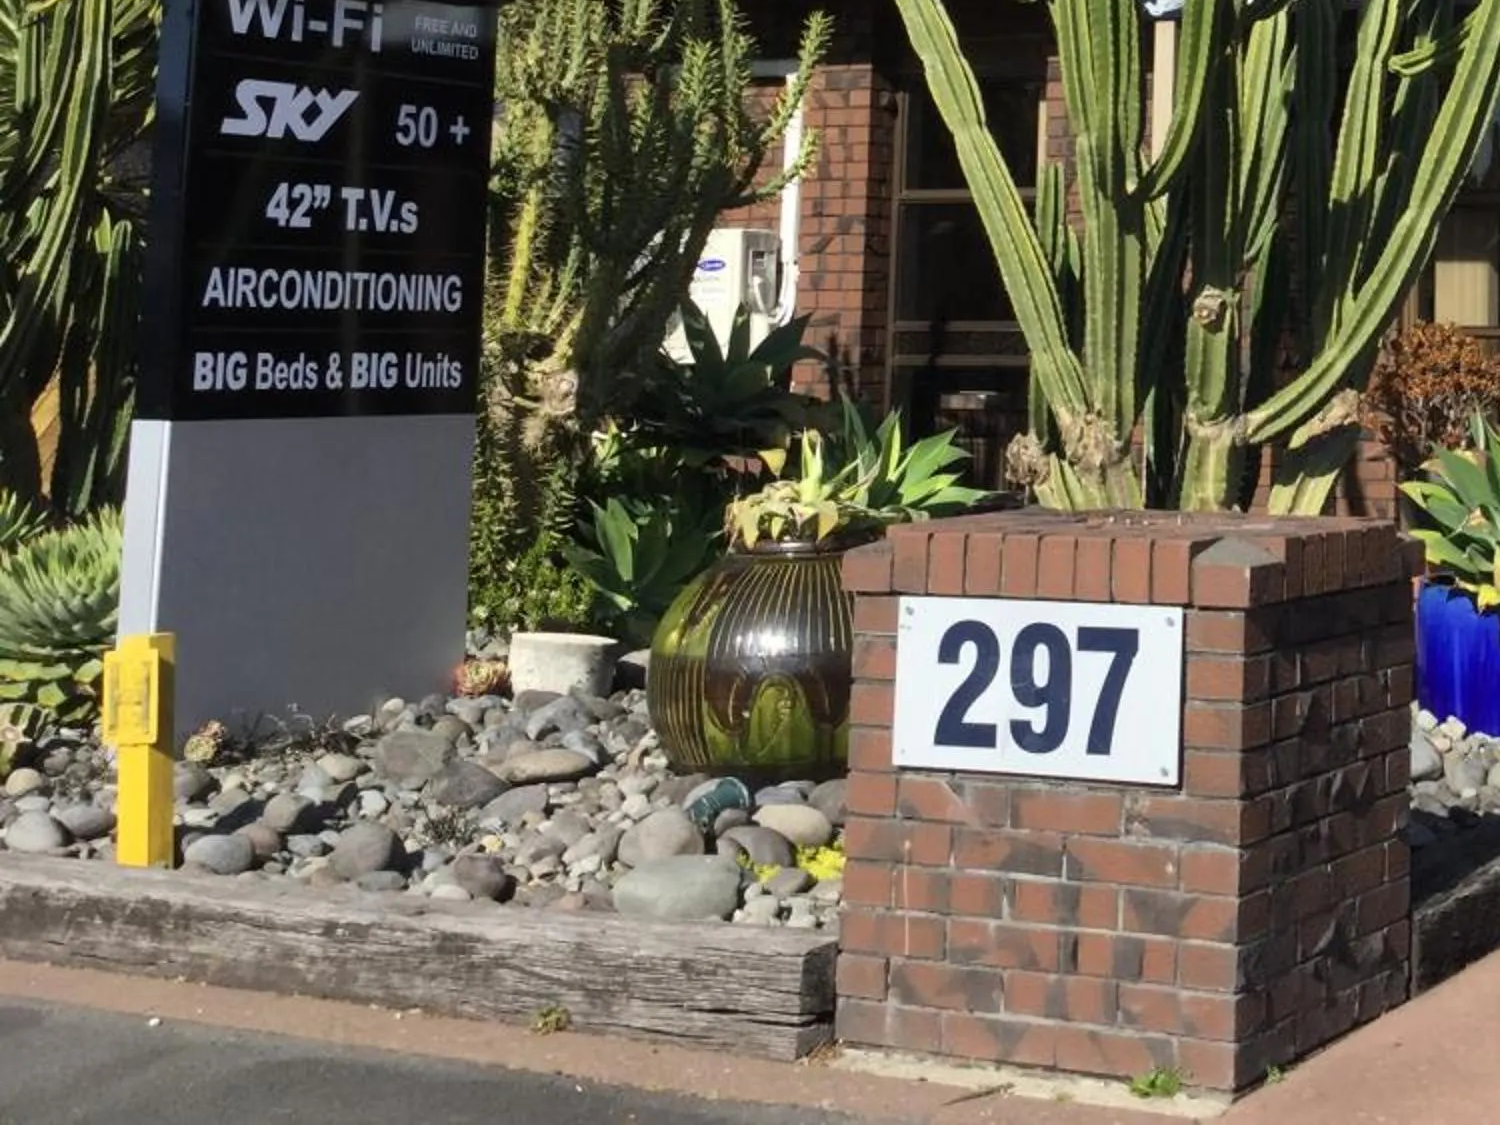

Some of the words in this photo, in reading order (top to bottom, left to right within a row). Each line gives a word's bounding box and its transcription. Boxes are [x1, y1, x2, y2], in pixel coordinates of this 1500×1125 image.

[410, 36, 480, 61] UNLIMITED
[414, 15, 449, 35] FREE
[450, 20, 478, 39] AND
[220, 78, 361, 142] SKY
[395, 104, 438, 148] 50
[341, 186, 420, 235] T.V.s
[202, 267, 463, 313] AIRCONDITIONING
[193, 350, 247, 392] BIG
[255, 350, 318, 391] Beds
[326, 352, 344, 390] &
[350, 351, 399, 390] BIG
[405, 352, 462, 390] Units
[933, 619, 1140, 756] 297
